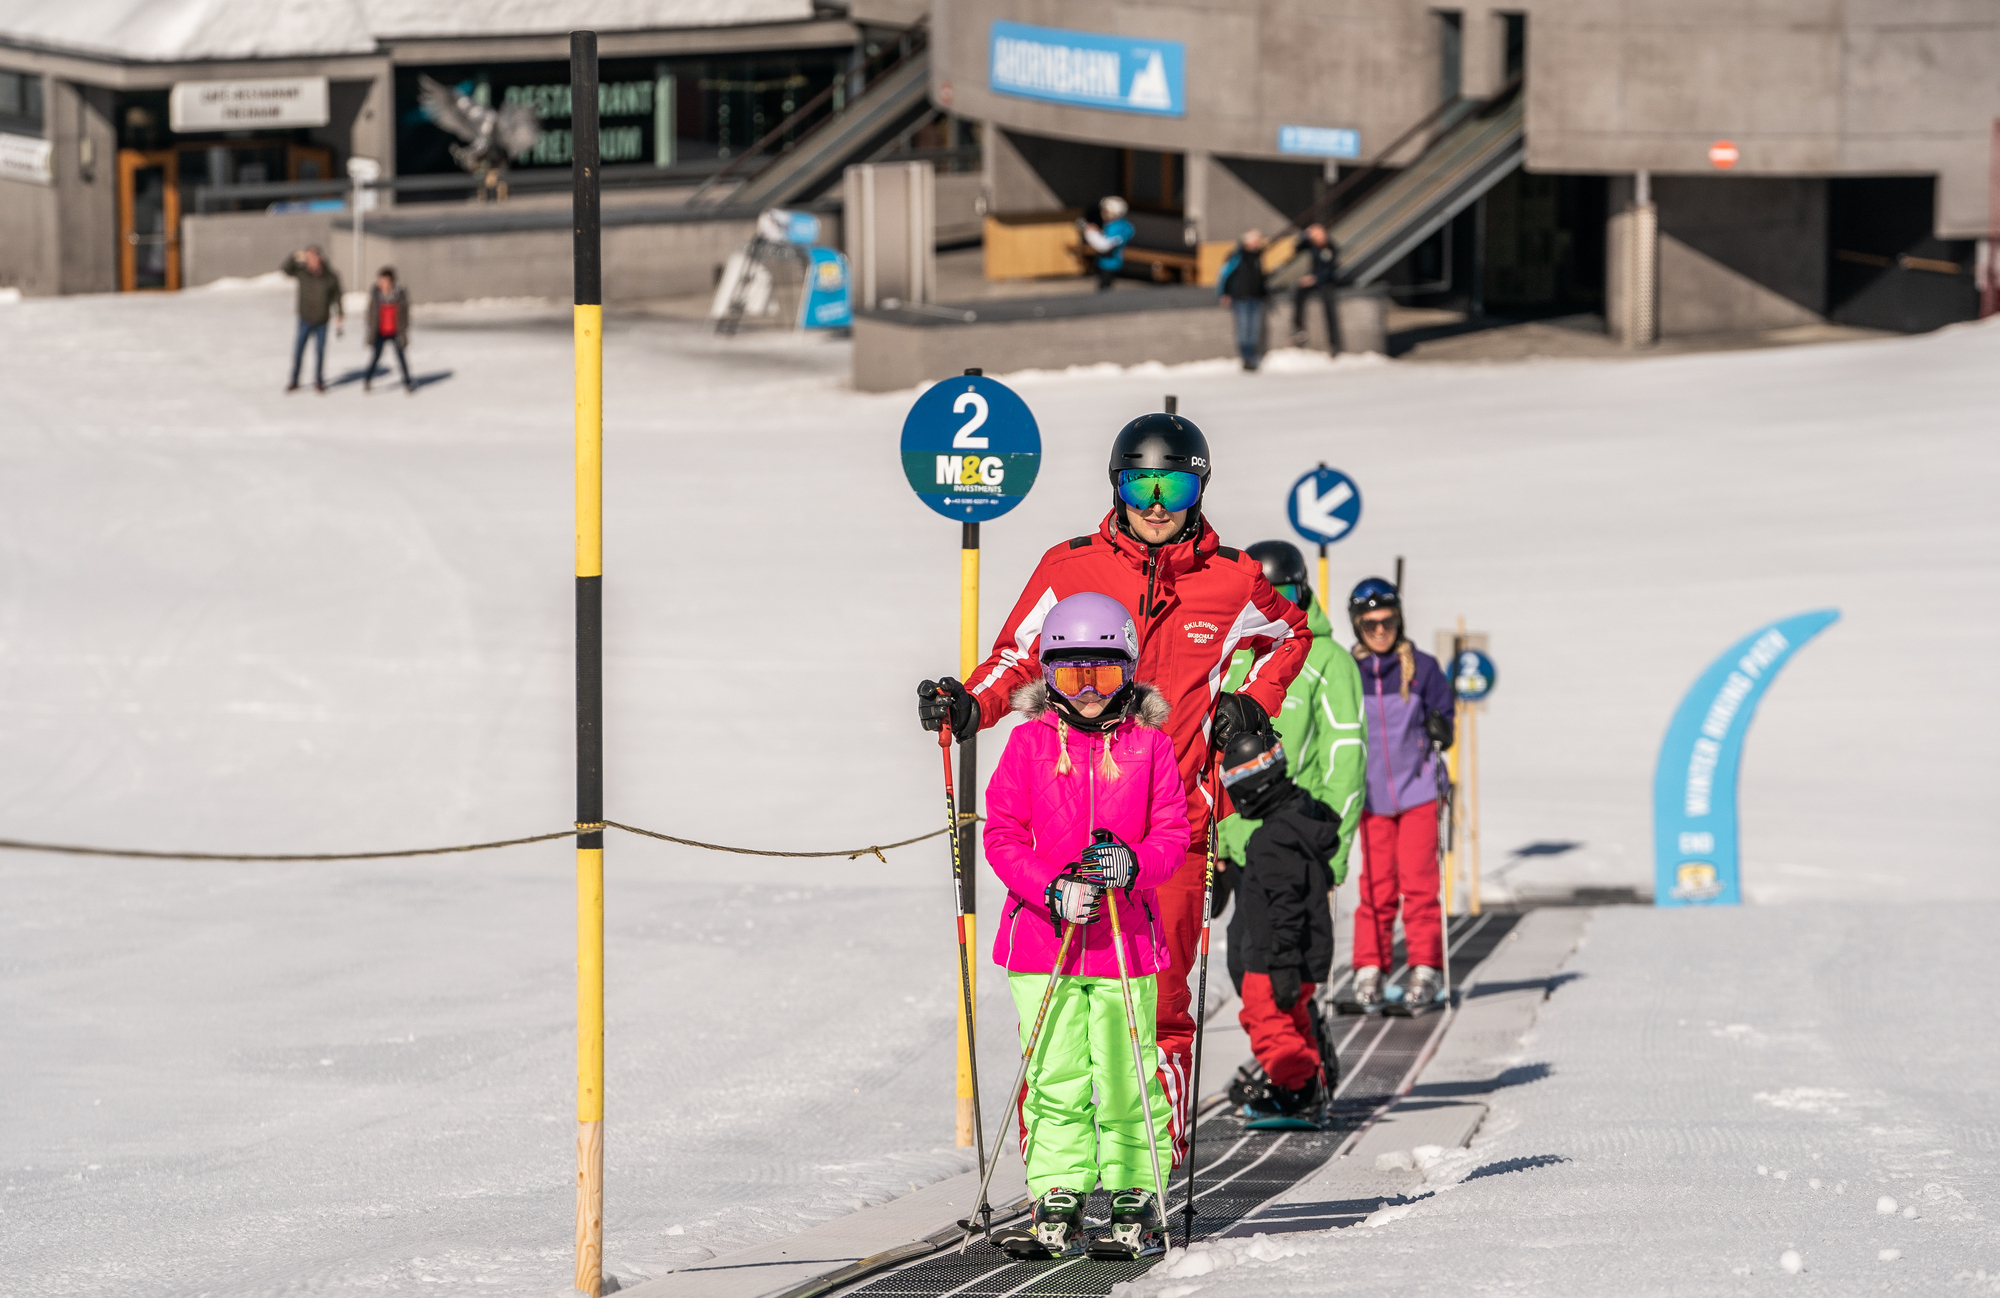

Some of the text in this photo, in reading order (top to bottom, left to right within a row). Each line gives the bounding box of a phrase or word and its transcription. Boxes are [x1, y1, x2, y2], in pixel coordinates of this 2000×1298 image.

[995, 36, 1120, 98] AHORNBAHN
[953, 392, 989, 449] 2
[936, 454, 1005, 487] M&G
[953, 485, 1003, 493] INVESTMENTS
[1183, 620, 1219, 633] SKILEHRER
[1738, 627, 1790, 680] PATH
[1701, 669, 1755, 741] HIKING
[1684, 737, 1722, 818] WINTER
[1205, 851, 1214, 887] LEKI
